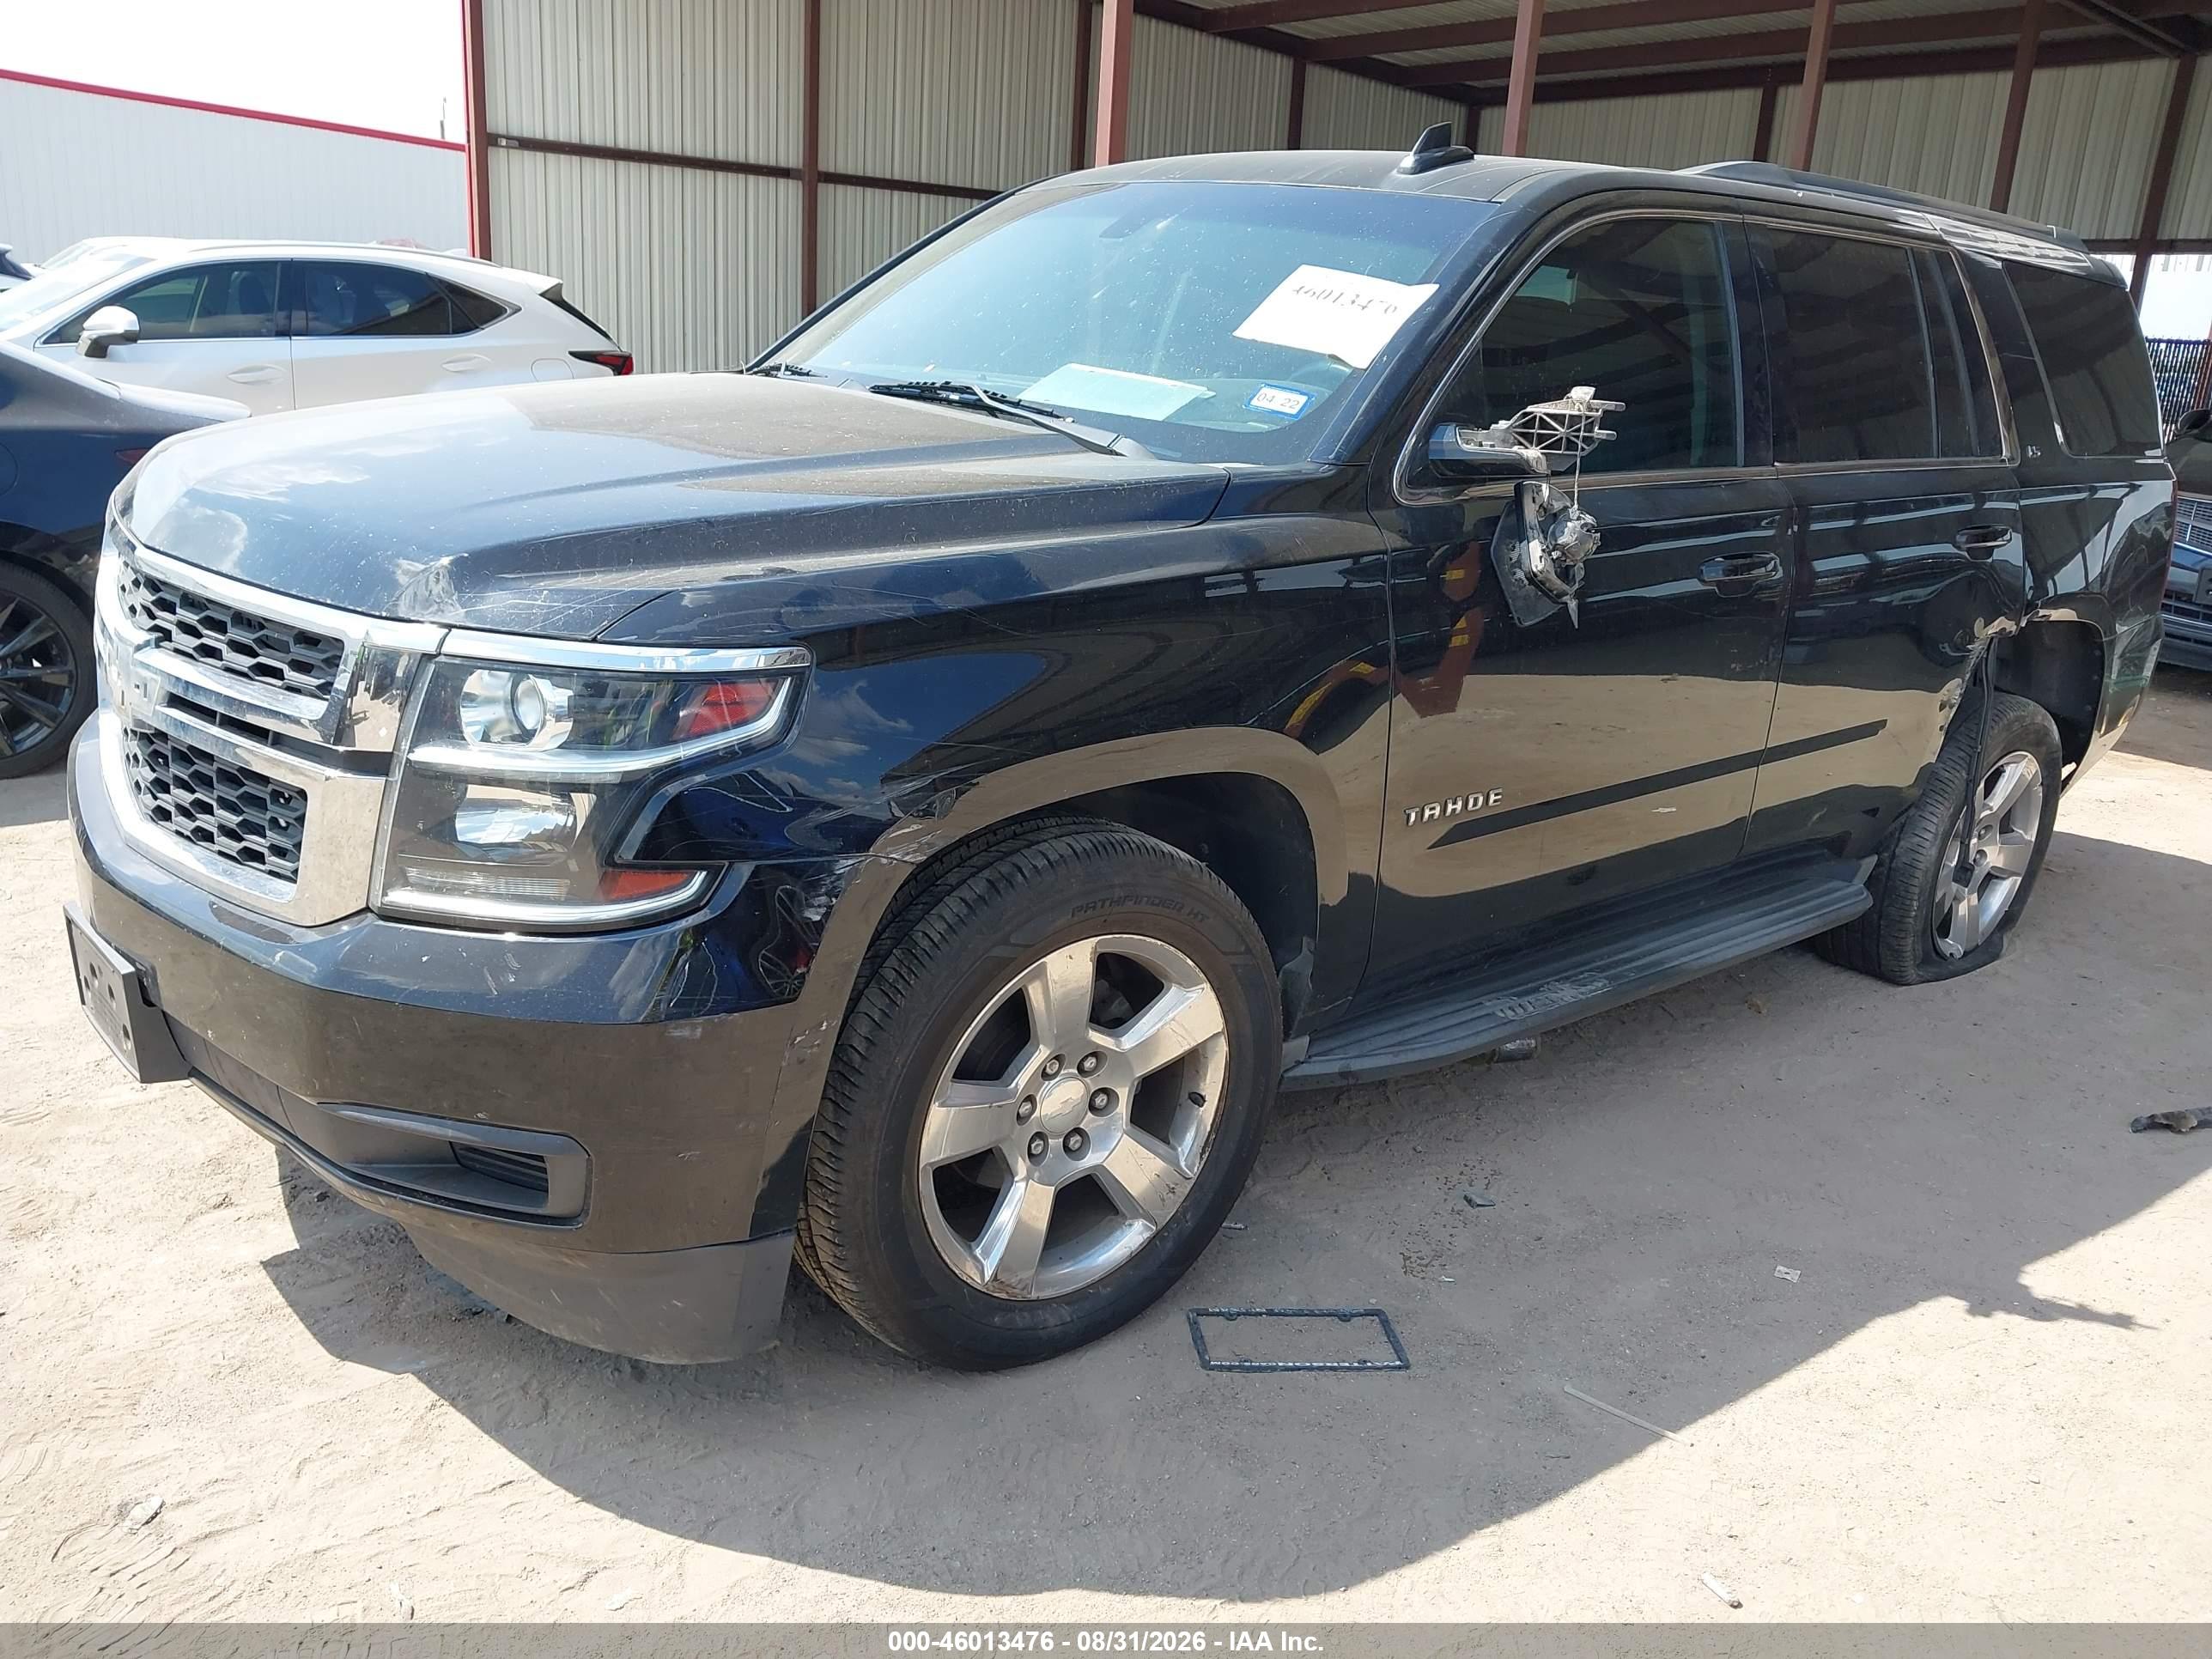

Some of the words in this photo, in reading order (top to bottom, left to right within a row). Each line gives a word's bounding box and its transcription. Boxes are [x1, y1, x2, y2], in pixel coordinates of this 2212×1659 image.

[1279, 398, 1300, 410] 22
[1404, 787, 1504, 827] TAHOE
[1070, 894, 1186, 919] PATHFINDER
